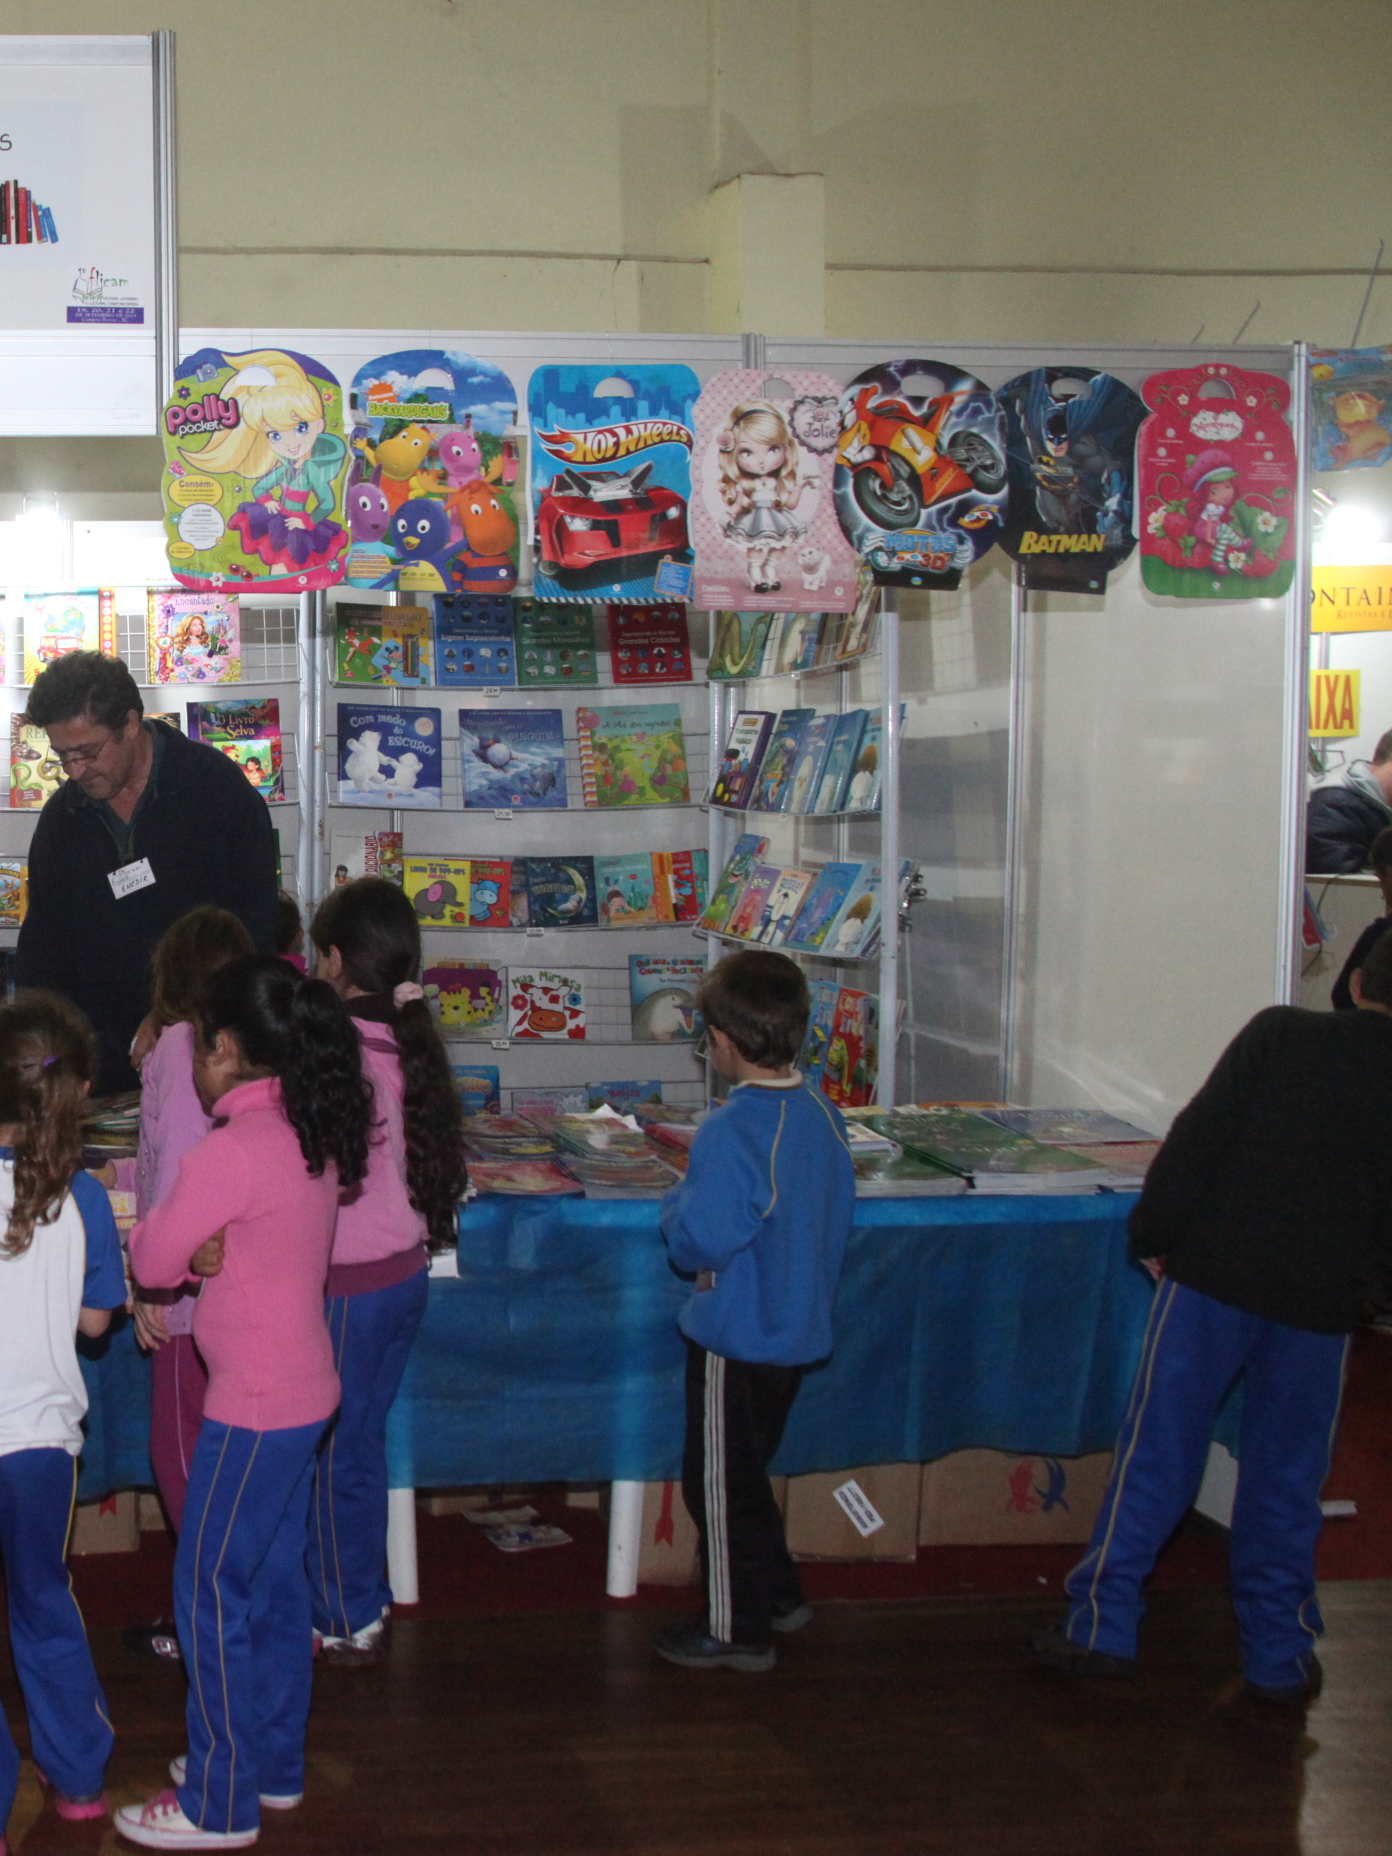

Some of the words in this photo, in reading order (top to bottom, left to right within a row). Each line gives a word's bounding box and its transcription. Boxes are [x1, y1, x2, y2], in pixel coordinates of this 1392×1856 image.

[167, 393, 238, 432] polly
[369, 403, 447, 418] BACKYARDIGANS
[179, 420, 220, 438] pocket
[803, 422, 835, 438] Jolie
[885, 532, 957, 552] MOTOS
[1018, 531, 1106, 554] BATMAN
[920, 553, 946, 571] 3D
[175, 596, 214, 606] Encantado
[1310, 586, 1392, 607] NTAI
[651, 636, 680, 644] Cidades
[1309, 674, 1355, 730] IXA
[228, 714, 255, 725] Livro
[349, 715, 374, 728] Com
[378, 713, 406, 726] medo
[226, 725, 256, 739] Selva
[393, 726, 403, 734] do
[388, 736, 436, 756] ESCURO!
[511, 974, 535, 989] Mila
[539, 970, 582, 992] Mimosa
